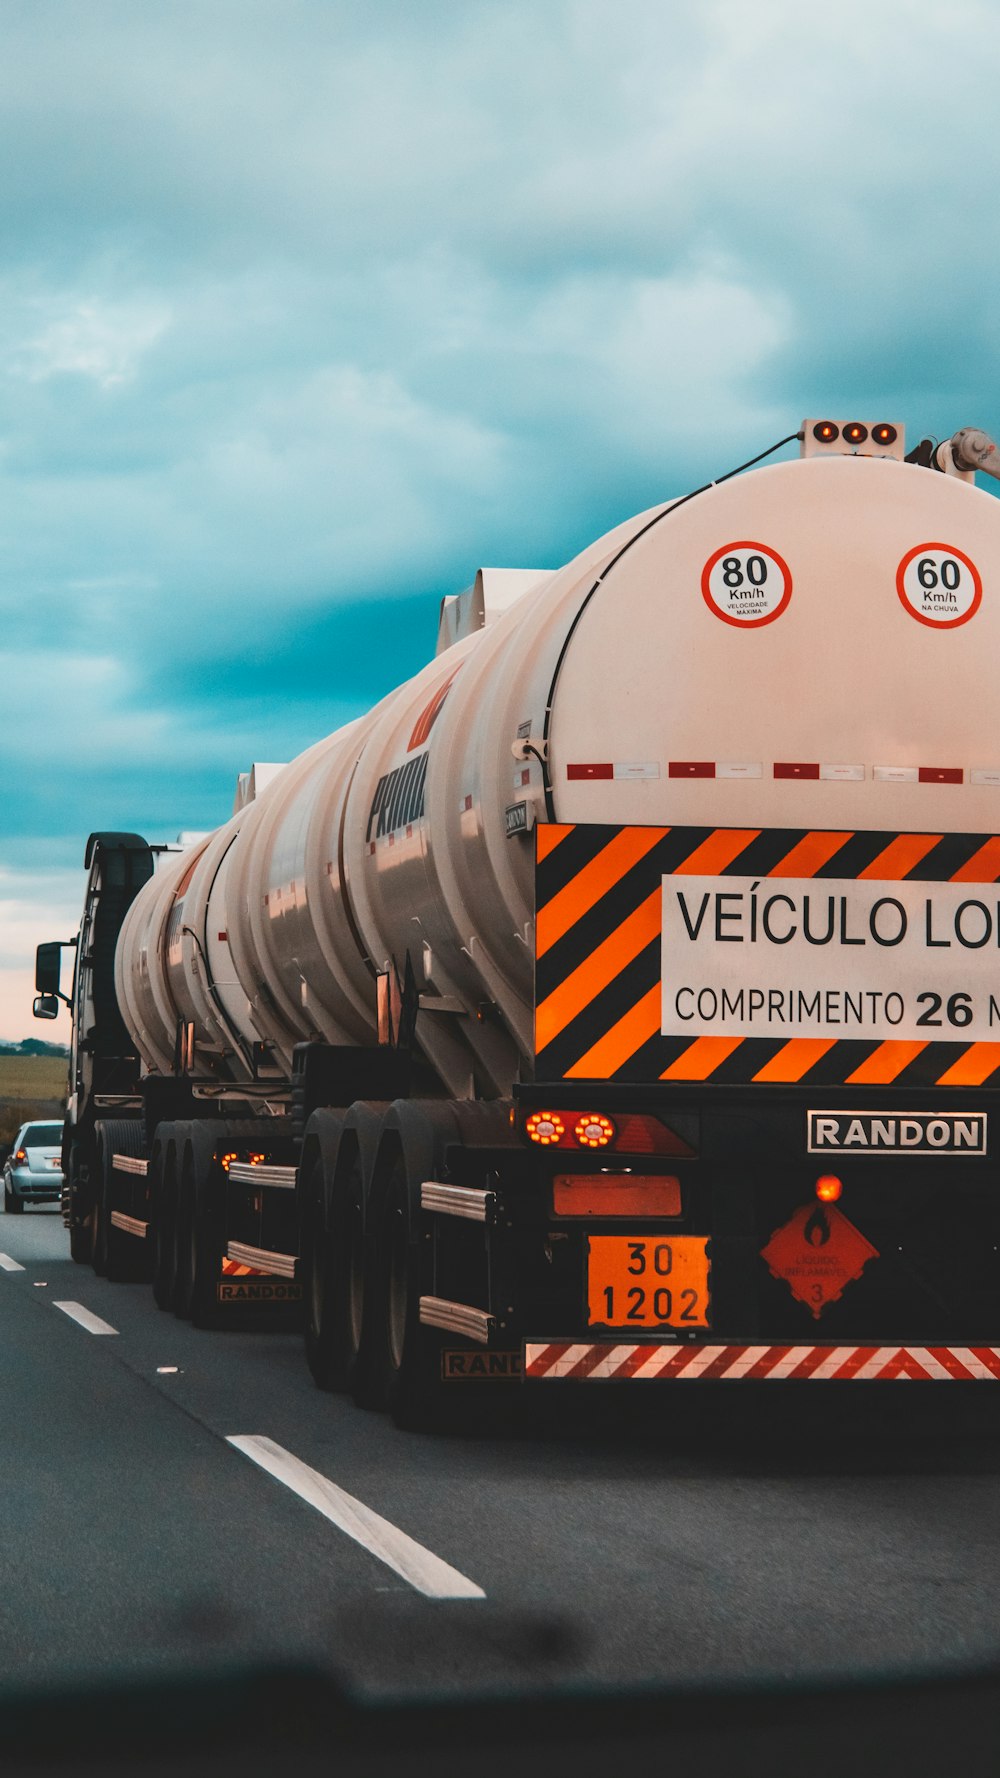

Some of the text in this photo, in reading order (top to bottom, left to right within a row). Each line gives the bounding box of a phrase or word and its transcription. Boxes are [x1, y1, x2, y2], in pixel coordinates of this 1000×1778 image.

[722, 555, 768, 588] 80
[917, 558, 961, 590] 60
[727, 601, 769, 609] VELOCIDADE
[729, 588, 765, 600] Km/h
[923, 591, 957, 603] Km/h
[676, 881, 1000, 949] VEÍCULO LO
[675, 987, 905, 1025] COMPRIMENTO
[915, 991, 973, 1028] 26
[816, 1118, 979, 1147] RANDON
[627, 1243, 673, 1276] 30
[222, 1286, 301, 1299] RANDON
[603, 1286, 698, 1321] 1202
[810, 1284, 823, 1303] 3
